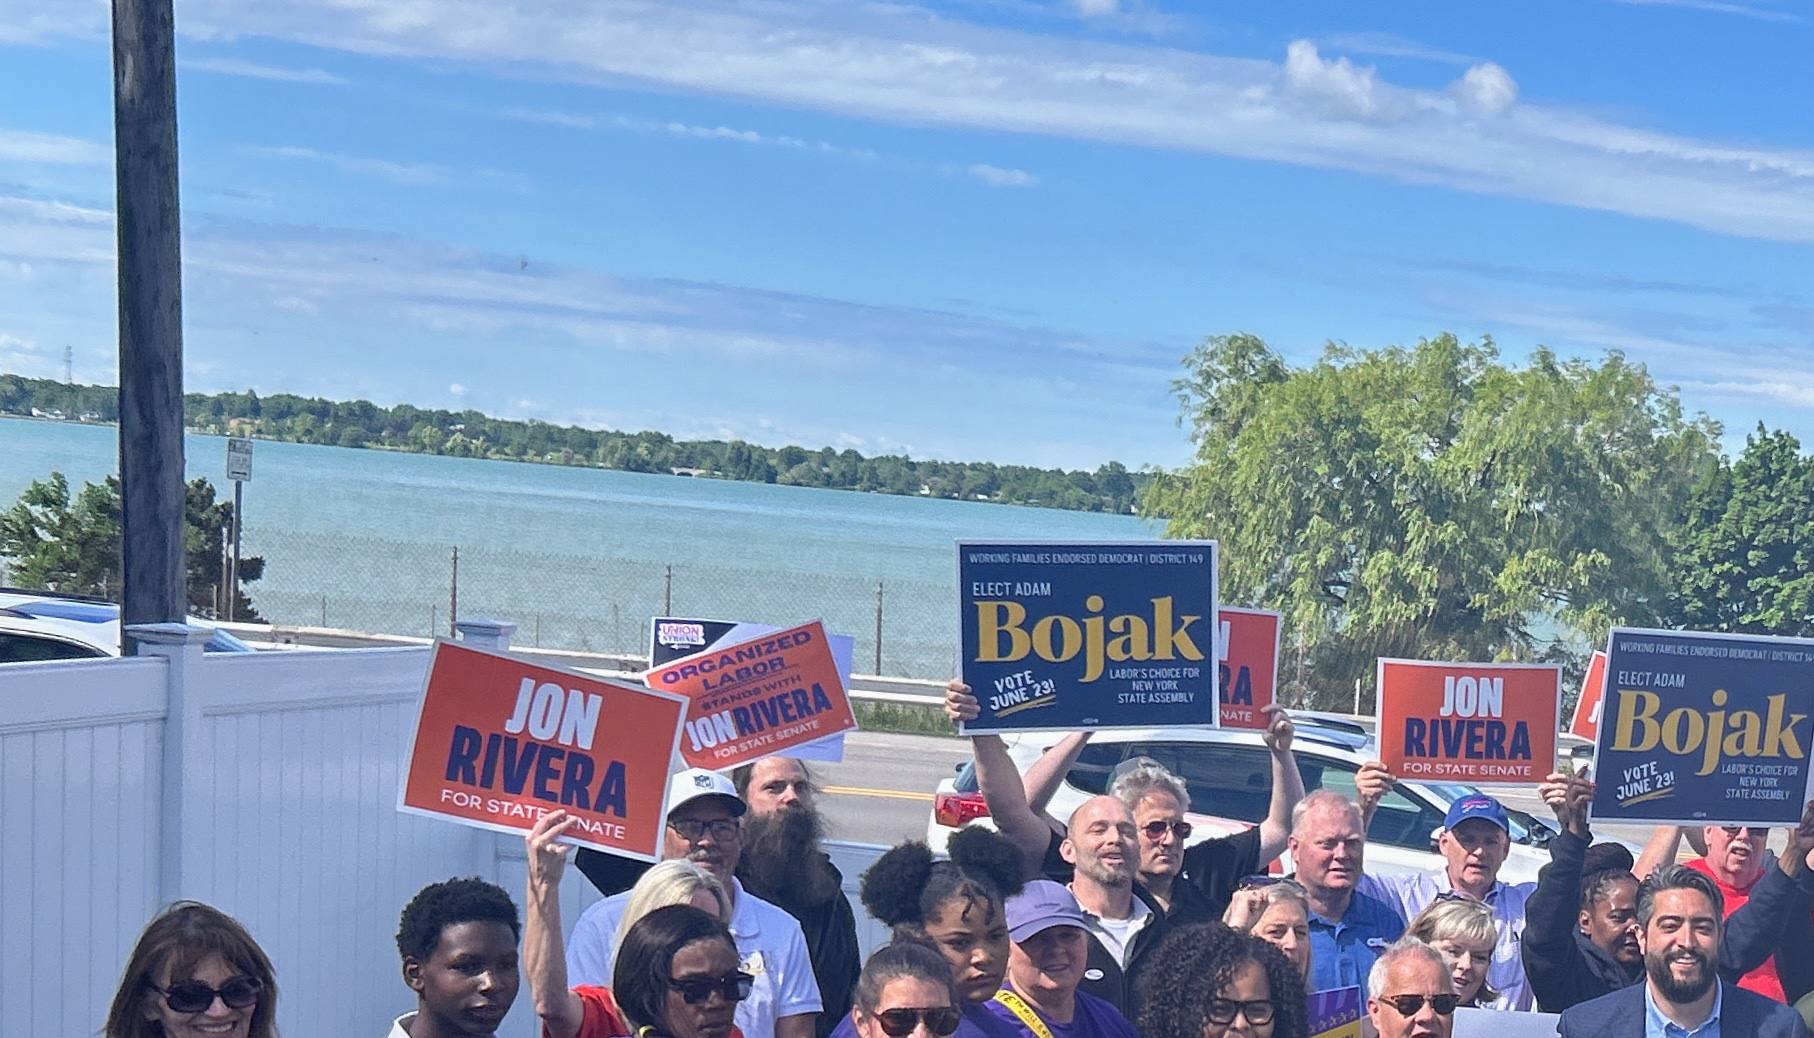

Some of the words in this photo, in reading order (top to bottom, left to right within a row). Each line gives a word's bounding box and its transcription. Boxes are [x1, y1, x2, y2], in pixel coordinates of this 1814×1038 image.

[969, 553, 1009, 564] WORKING
[1012, 553, 1050, 564] FAMILIES
[1052, 553, 1097, 564] ENDORSED
[1099, 553, 1143, 564] DEMOCRAT
[1150, 554, 1187, 564] DISTRICT
[1189, 554, 1203, 564] 149
[973, 583, 1010, 597] ELECT
[1015, 583, 1051, 596] ADAM
[663, 626, 699, 635] UNION
[973, 595, 1205, 683] Bojak
[662, 630, 812, 684] ORGANIZED
[1620, 642, 1654, 653] WORKING
[1655, 644, 1688, 656] FAMILIES
[1690, 646, 1727, 658] ENDORSED
[1729, 648, 1766, 660] DEMOCRAT
[1772, 651, 1803, 662] DISTRICT
[702, 657, 785, 691] LABOR
[994, 671, 1035, 694] VOTE
[1110, 668, 1147, 680] LABOR'S
[1150, 668, 1180, 679] CHOICE
[1183, 667, 1199, 678] FOR
[1618, 671, 1650, 685] ELECT
[1654, 673, 1685, 688] ADAM
[702, 688, 761, 711] STANDS
[765, 676, 802, 692] WITH
[990, 688, 1029, 711] JUNE
[1034, 678, 1056, 699] 23!
[1132, 680, 1151, 691] NEW
[1154, 680, 1178, 691] YORK
[1440, 676, 1503, 718] JON
[1118, 693, 1146, 704] STATE
[1149, 693, 1194, 704] ASSEMBLY
[505, 678, 603, 750] JON
[714, 745, 738, 759] FOR
[739, 733, 774, 753] STATE
[776, 720, 820, 741] SENATE
[1404, 718, 1532, 760] RIVERA
[1610, 689, 1807, 775] Bojak
[446, 725, 626, 818] RIVERA
[1403, 764, 1432, 773] FOR
[1436, 764, 1476, 775] STATE
[1480, 765, 1531, 776] SENATE
[1623, 761, 1658, 782] VOTE
[1722, 764, 1754, 775] LABOR'S
[1755, 765, 1781, 775] CHOICE
[1784, 766, 1798, 775] FOR
[1617, 780, 1651, 800] JUNE
[1656, 771, 1675, 789] 23!
[1739, 777, 1756, 786] NEW
[1757, 777, 1778, 787] YORK
[441, 789, 481, 810] FOR
[487, 800, 547, 822] STATE
[1726, 789, 1749, 799] STATE
[1750, 790, 1790, 800] ASSEMBLY
